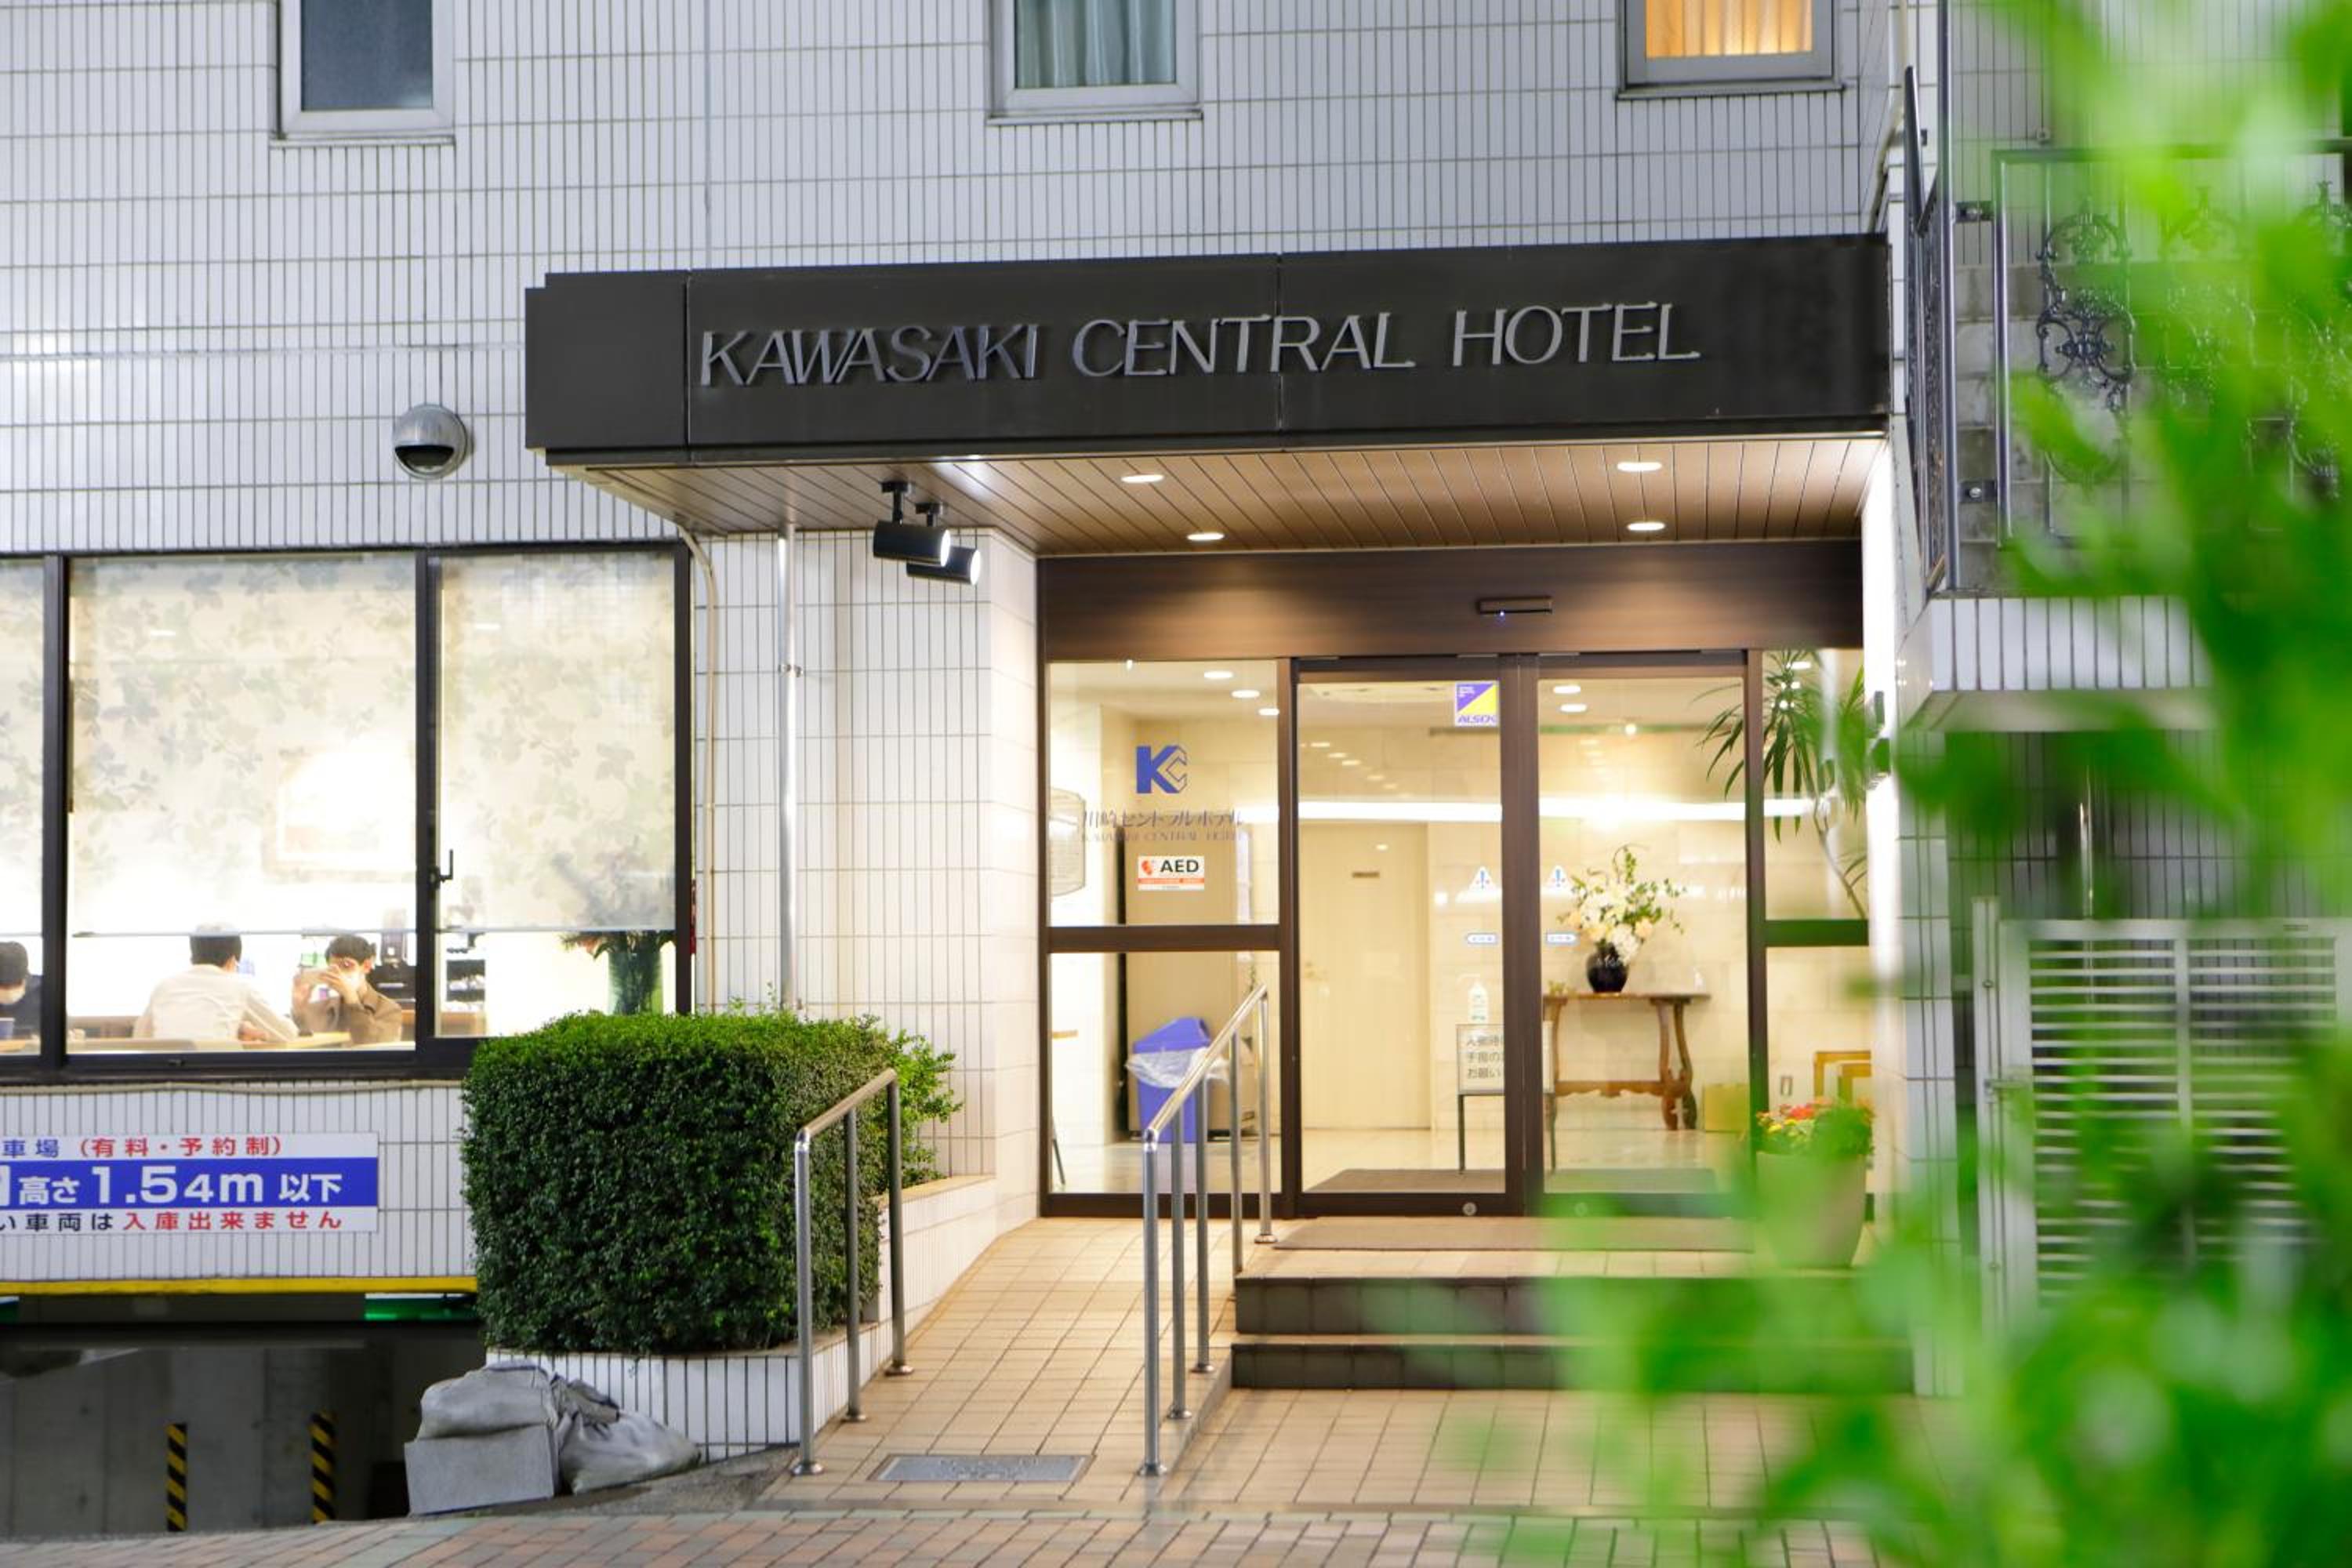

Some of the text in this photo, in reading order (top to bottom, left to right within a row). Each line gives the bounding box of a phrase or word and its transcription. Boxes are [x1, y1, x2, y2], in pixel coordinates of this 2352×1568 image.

[701, 301, 1700, 386] KAWASAKI CENTRAL HOTEL
[1160, 859, 1199, 873] AED
